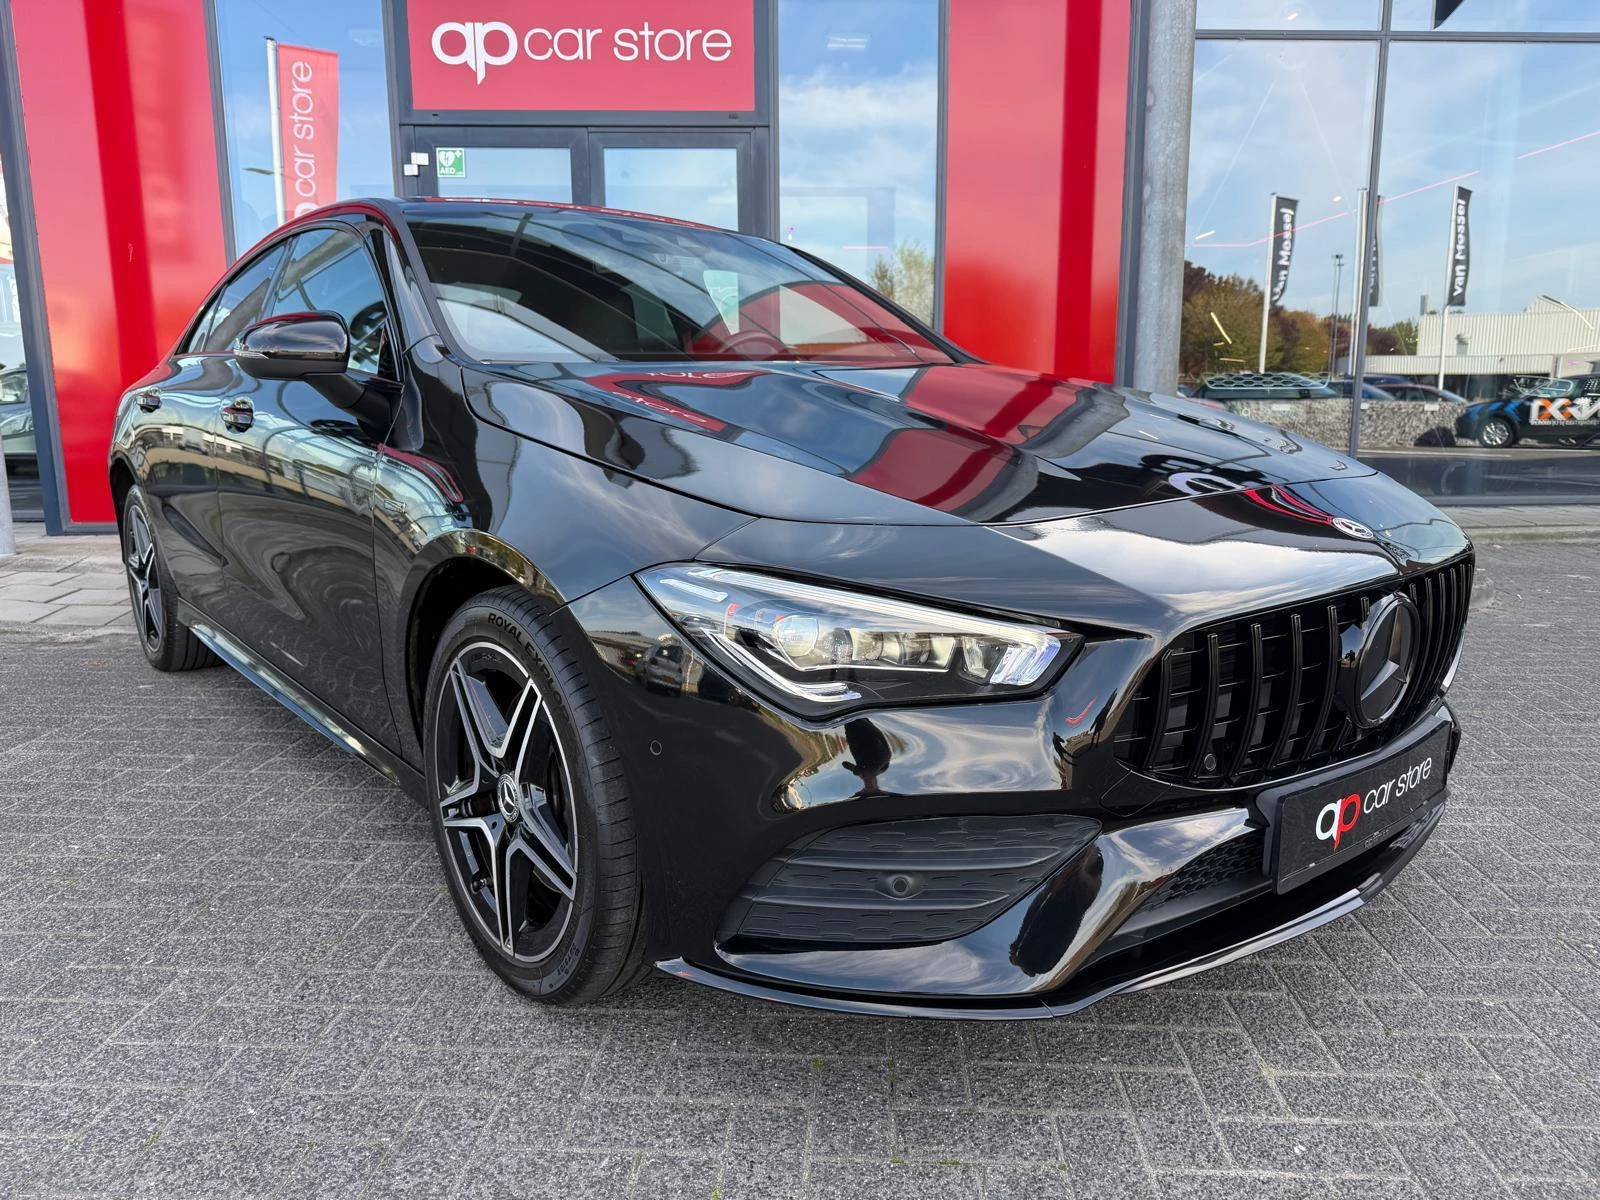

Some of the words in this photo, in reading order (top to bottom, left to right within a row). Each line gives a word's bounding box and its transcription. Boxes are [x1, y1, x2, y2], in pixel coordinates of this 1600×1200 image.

[523, 27, 603, 61] car
[613, 22, 732, 61] store
[289, 61, 314, 140] store
[294, 146, 317, 197] car
[440, 167, 456, 175] AED
[1455, 199, 1466, 260] Mossel
[488, 613, 522, 645] ROYAL
[1363, 779, 1396, 814] car
[1395, 757, 1432, 797] store
